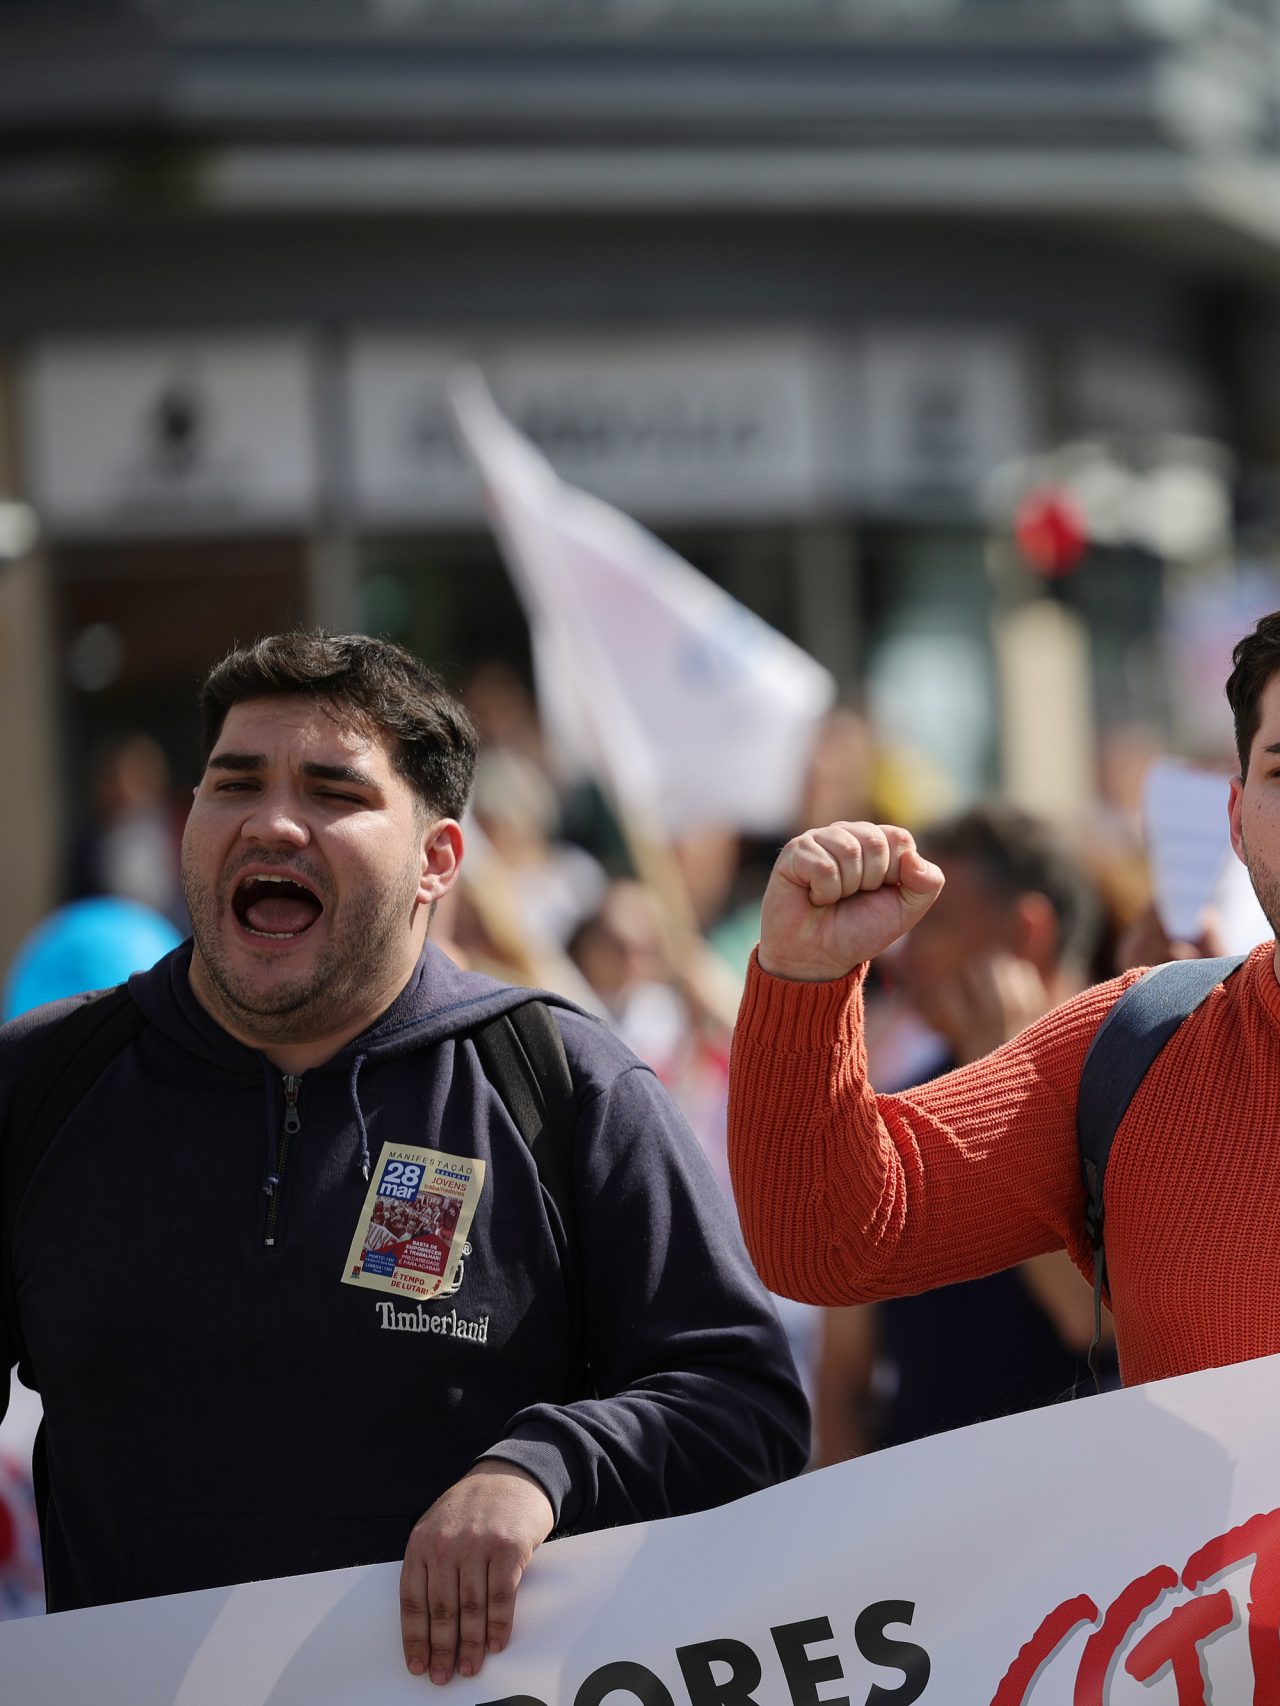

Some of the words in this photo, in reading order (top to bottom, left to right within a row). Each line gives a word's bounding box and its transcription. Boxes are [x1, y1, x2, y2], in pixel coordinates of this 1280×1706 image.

[389, 1151, 473, 1175] MANIFESTAÇÃO
[384, 1162, 421, 1187] 28
[380, 1182, 416, 1199] mar
[424, 1184, 465, 1197] trabalhadores
[432, 1176, 468, 1192] JOVENS
[393, 1271, 398, 1279] É
[399, 1274, 425, 1286] TEMPO
[391, 1280, 400, 1288] DE
[401, 1282, 429, 1295] LUTAR!
[376, 1302, 489, 1344] Timberland
[475, 1599, 931, 1706] RES
